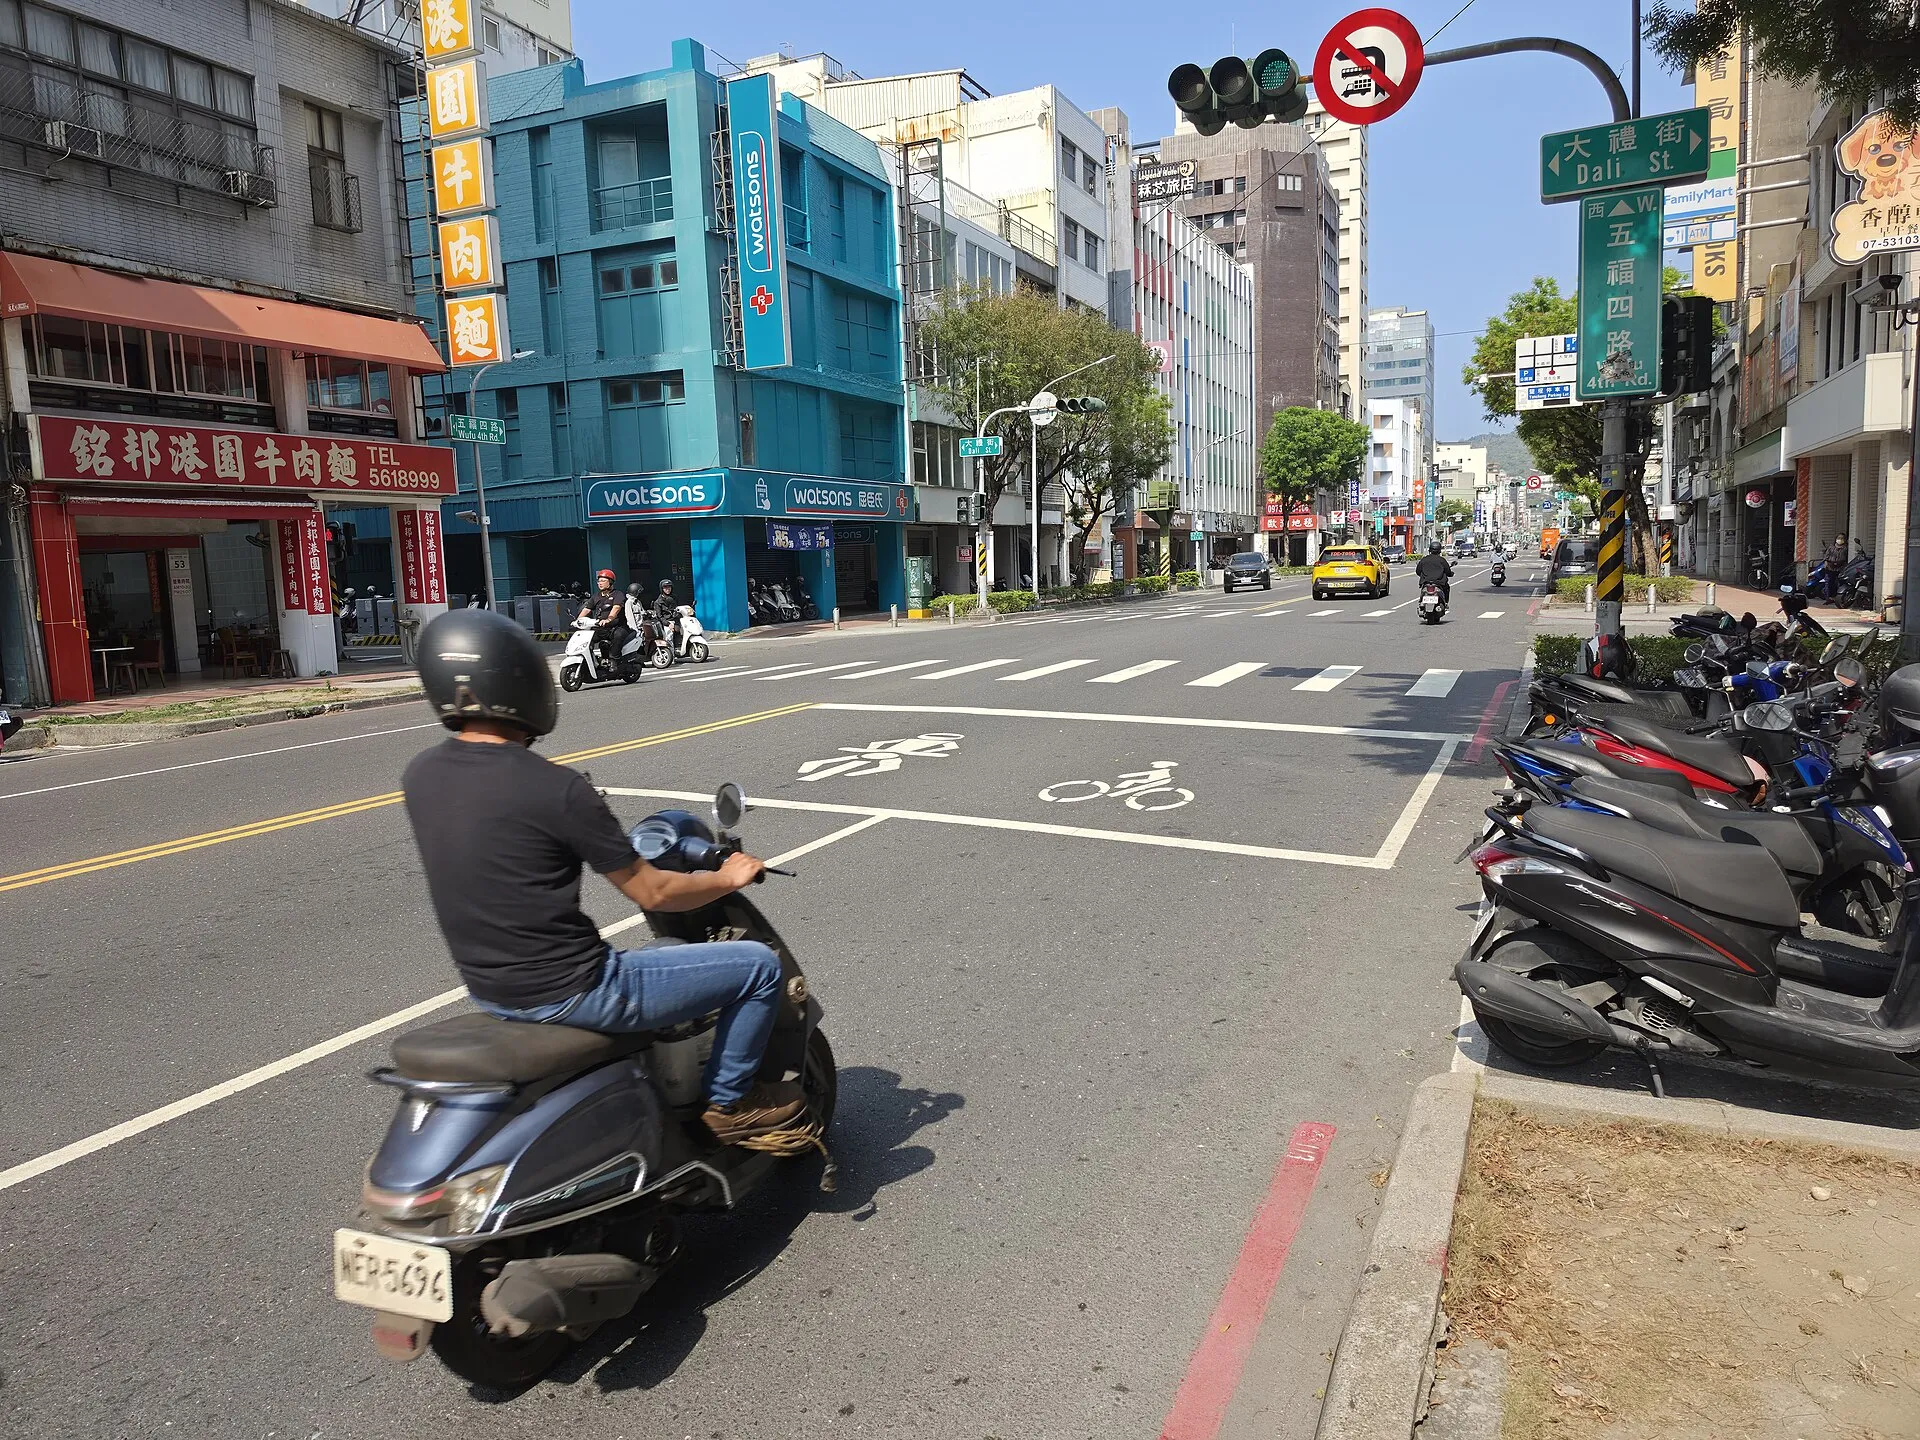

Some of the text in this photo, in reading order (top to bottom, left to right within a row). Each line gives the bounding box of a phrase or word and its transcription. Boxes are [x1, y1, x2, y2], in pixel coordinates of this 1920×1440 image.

[1563, 118, 1685, 161] 大禮街
[427, 0, 492, 358] 港園牛肉麵
[1138, 167, 1180, 181] Legend Hotel
[1577, 151, 1674, 185] Dali St.
[746, 151, 765, 255] watsons
[1637, 194, 1658, 213] W.
[1664, 186, 1733, 205] FamilyMart
[1588, 202, 1604, 219] 西
[1860, 203, 1920, 228] 香醇
[1689, 227, 1708, 239] ATM
[1606, 221, 1636, 357] 五福四路
[458, 430, 500, 442] Wufu 4th Rd.
[69, 424, 360, 486] 銘邦港園牛肉麵
[366, 445, 400, 466] TEL
[369, 468, 440, 489] 5618999
[603, 484, 706, 507] watsons
[793, 487, 883, 508] watsons 屈臣氏
[174, 560, 185, 569] 53
[402, 513, 419, 600] 銘邦港園牛肉麵
[424, 512, 441, 602] 銘邦港園牛肉麵
